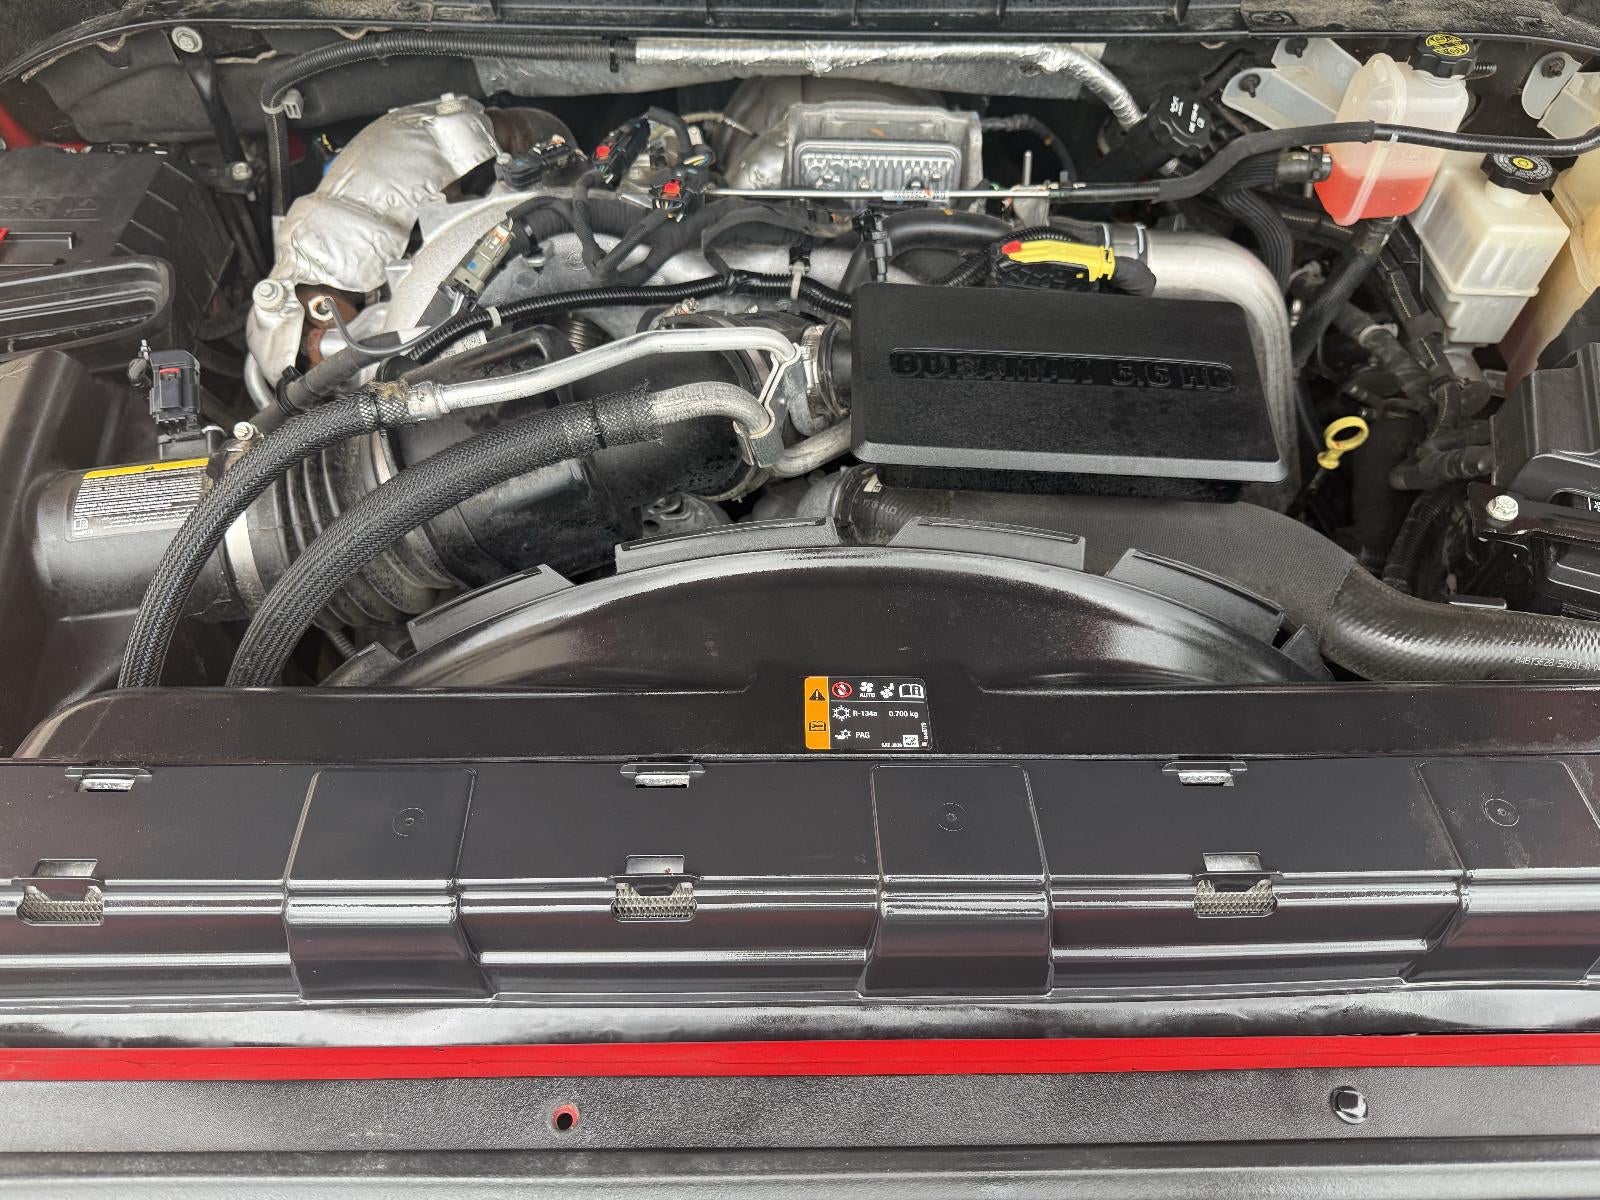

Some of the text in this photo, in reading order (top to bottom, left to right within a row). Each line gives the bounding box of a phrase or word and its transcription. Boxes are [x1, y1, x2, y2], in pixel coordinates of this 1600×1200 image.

[852, 709, 919, 719] R-134a 0.700 kg
[855, 731, 871, 739] PAG
